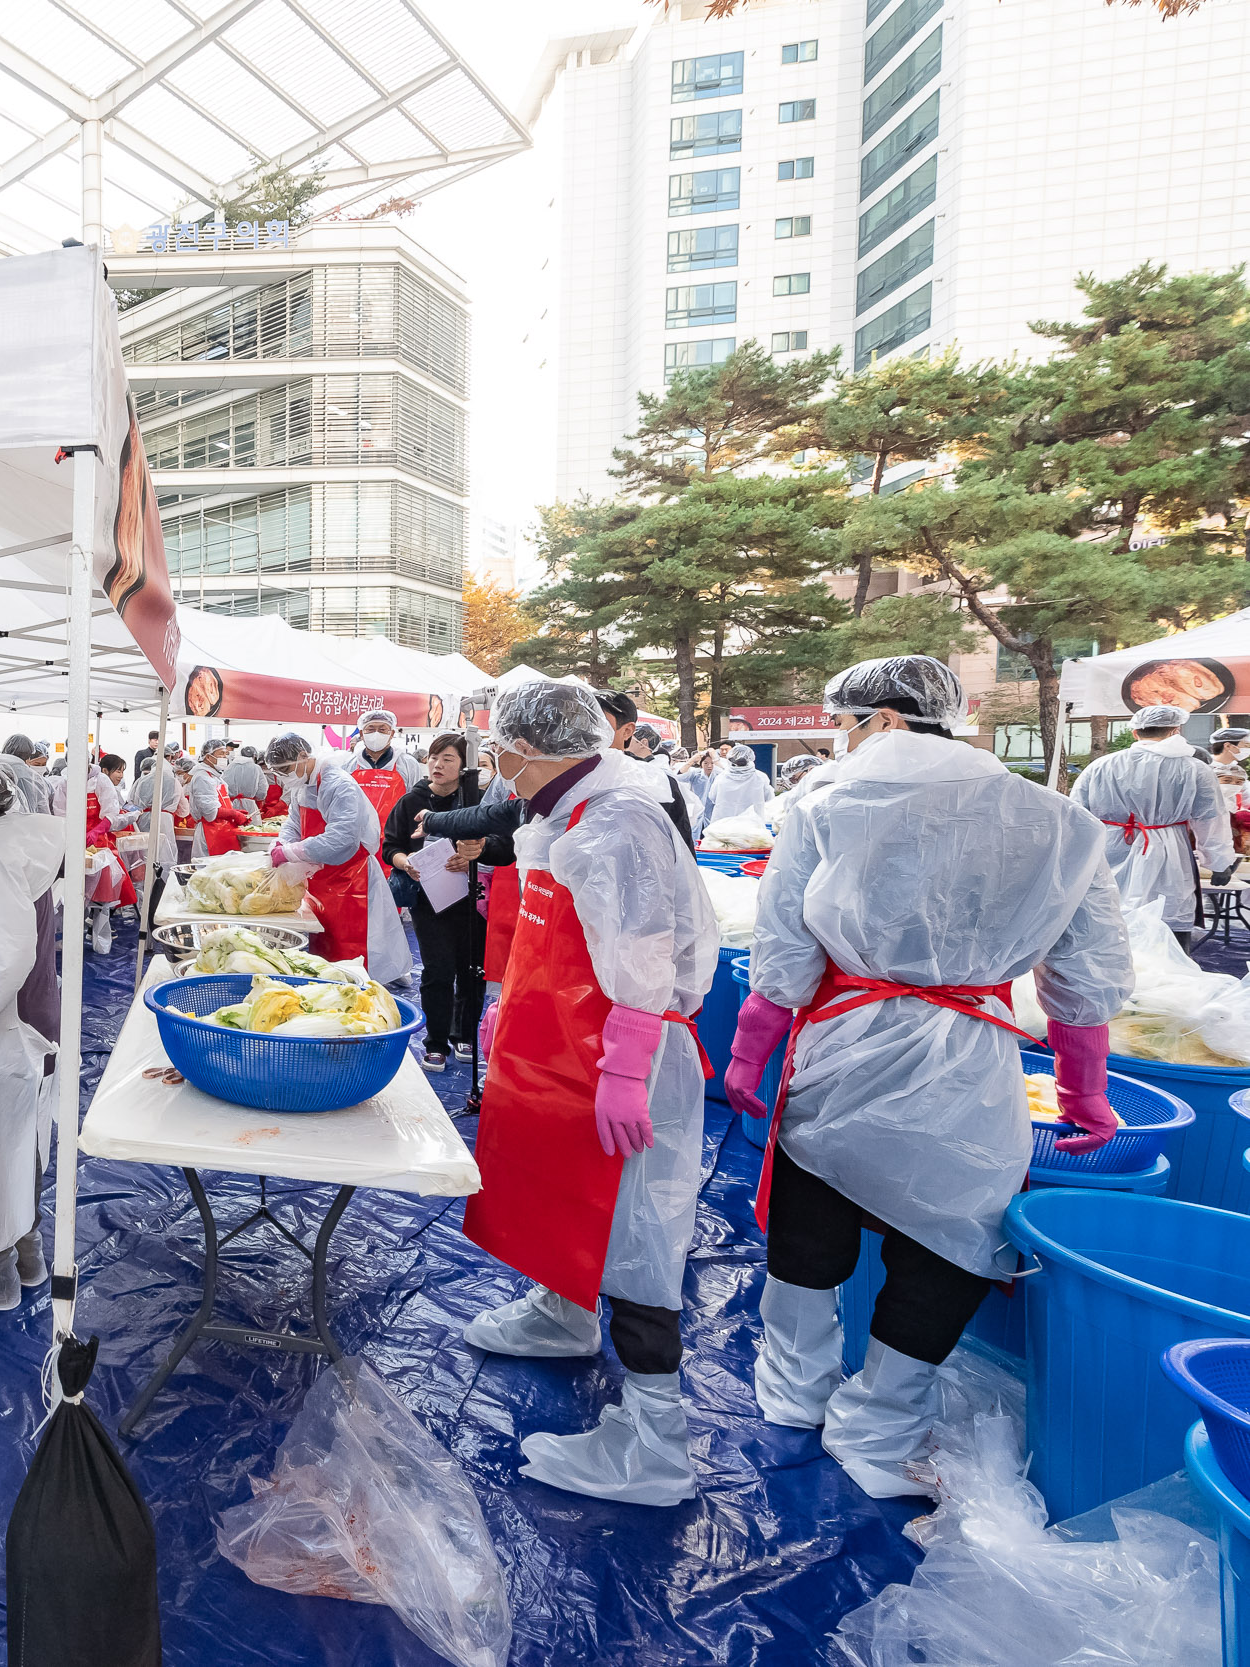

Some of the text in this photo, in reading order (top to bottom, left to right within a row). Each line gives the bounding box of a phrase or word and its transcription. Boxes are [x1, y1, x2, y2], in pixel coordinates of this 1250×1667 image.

[146, 218, 290, 253] 광진구의회
[757, 717, 782, 726] 2024
[784, 716, 815, 726] 제2회
[249, 1337, 277, 1346] LIFETIME
